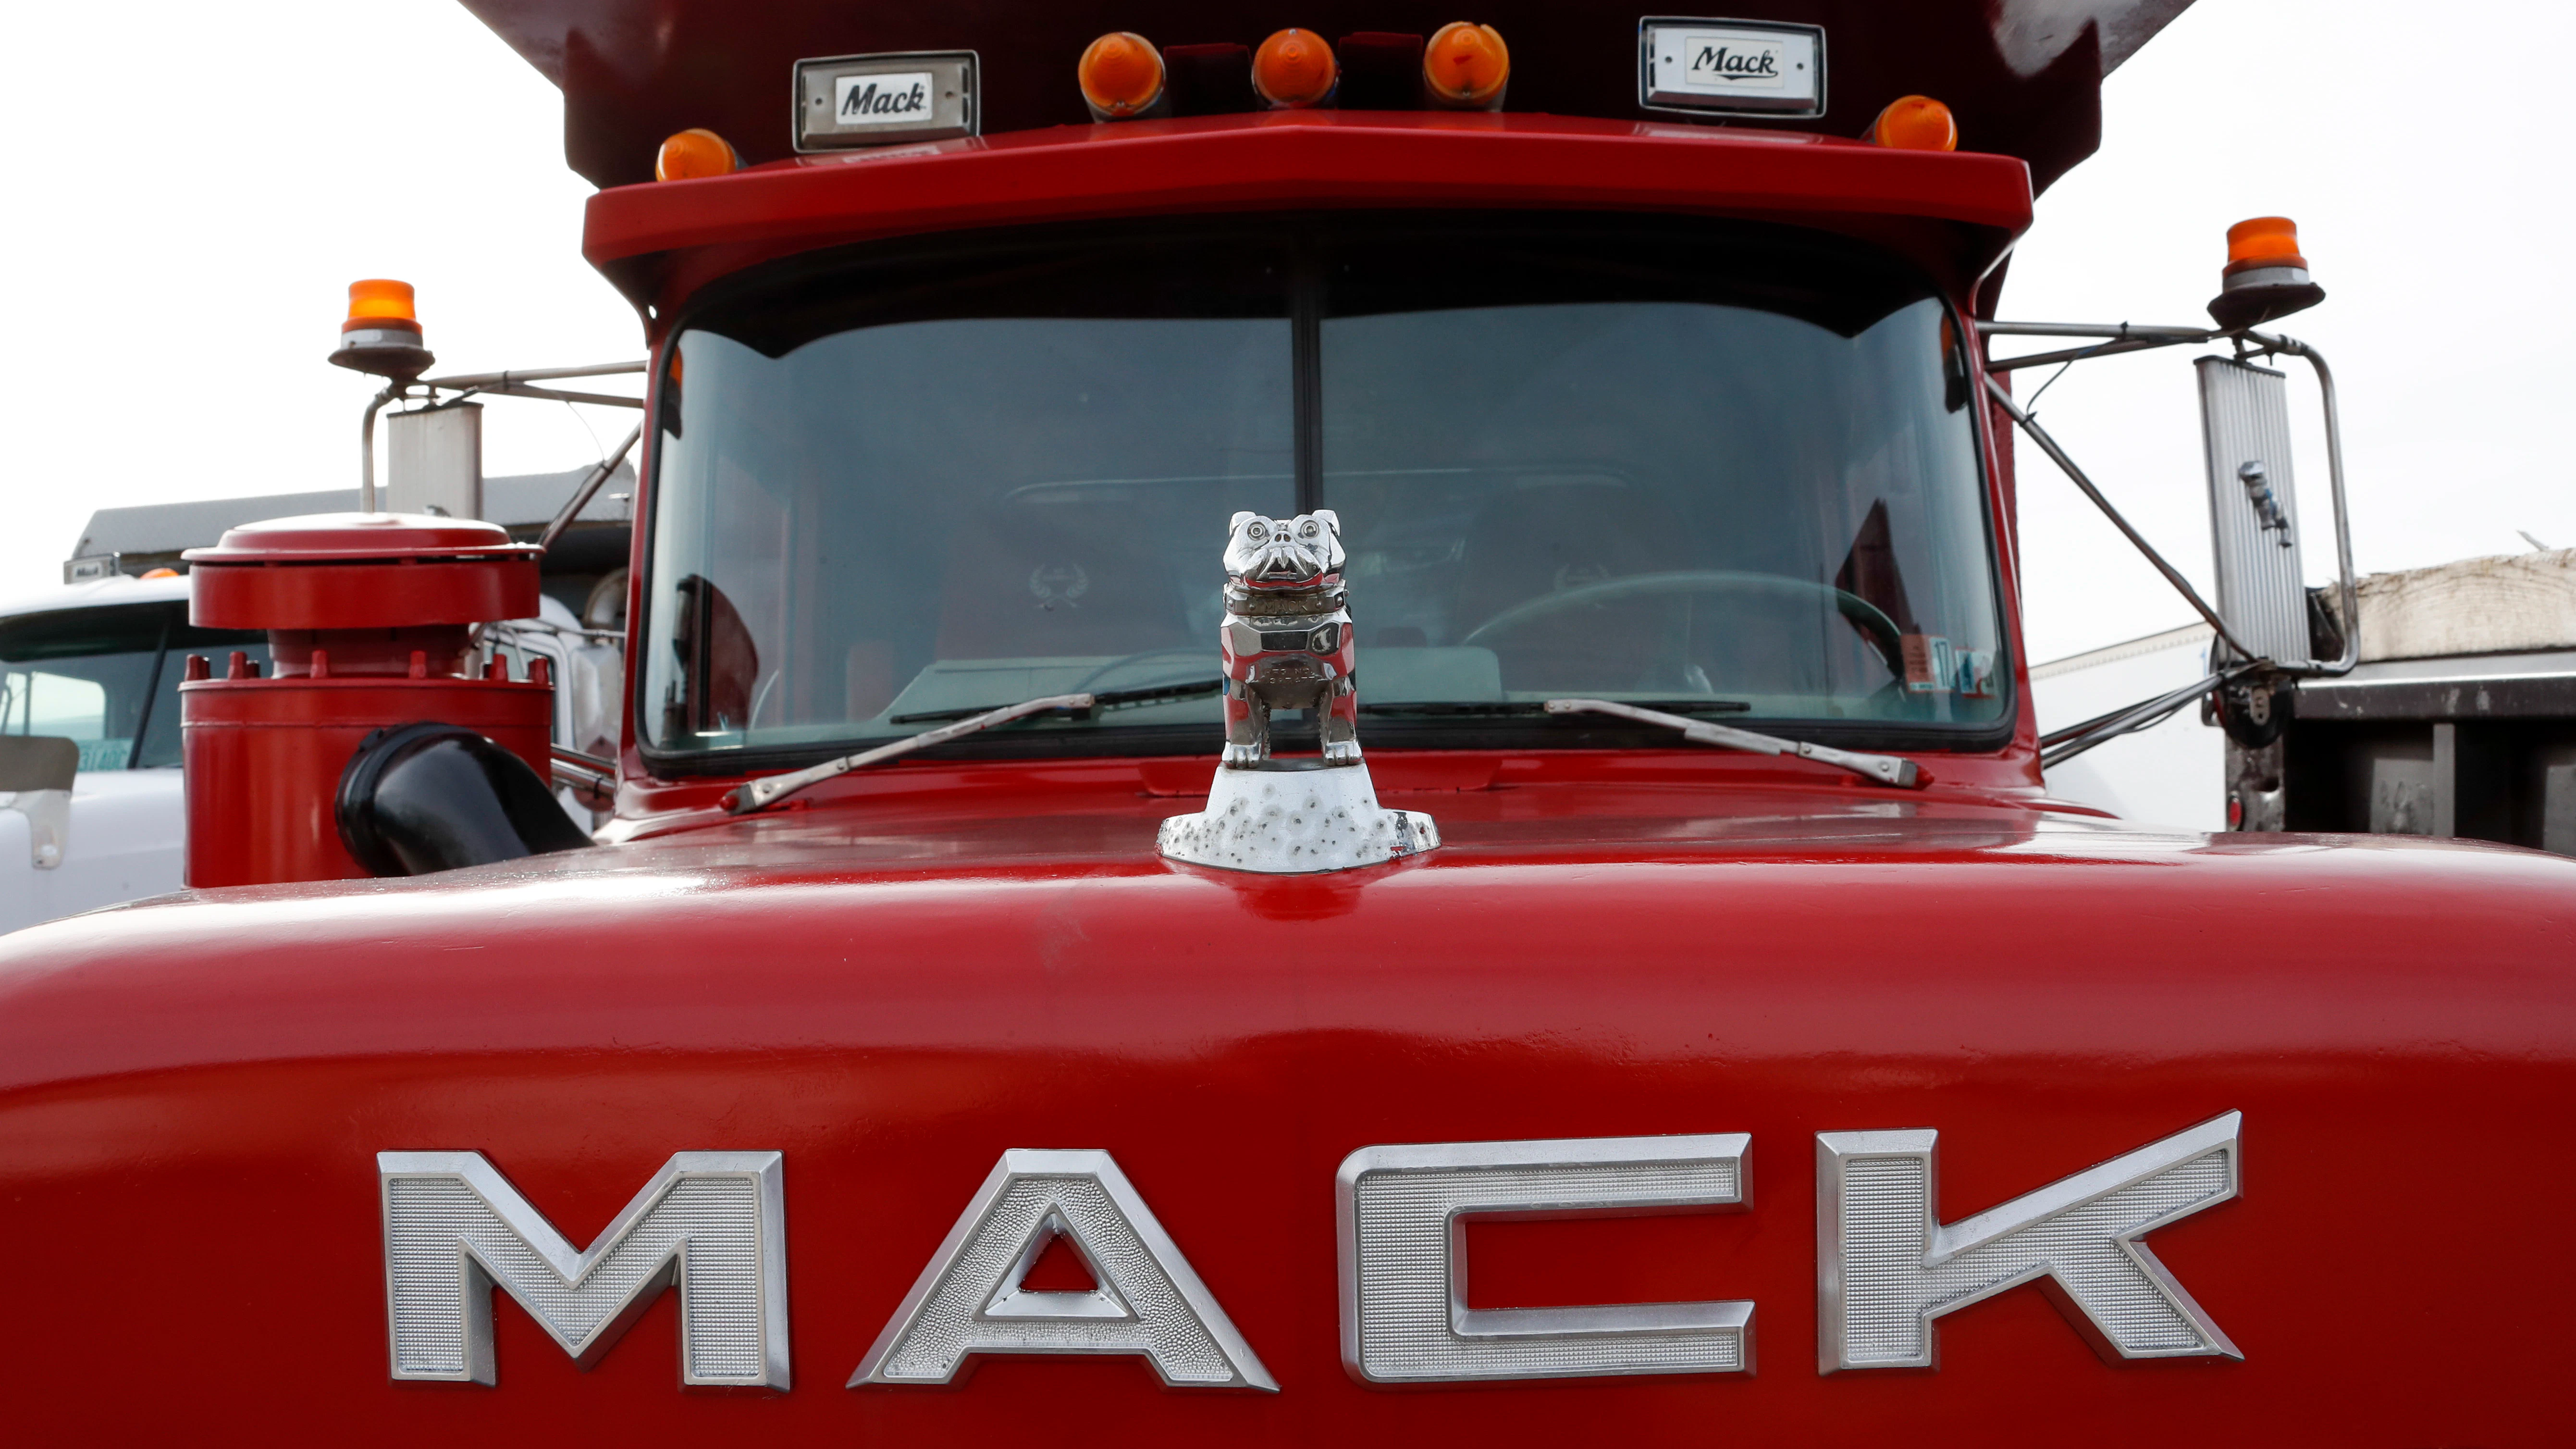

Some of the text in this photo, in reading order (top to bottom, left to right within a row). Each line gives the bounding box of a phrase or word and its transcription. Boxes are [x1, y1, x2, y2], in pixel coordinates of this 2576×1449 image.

[1691, 46, 1779, 81] Mack
[841, 82, 925, 116] Mack
[1263, 599, 1308, 614] MACK
[376, 1109, 2243, 1393] MACK
